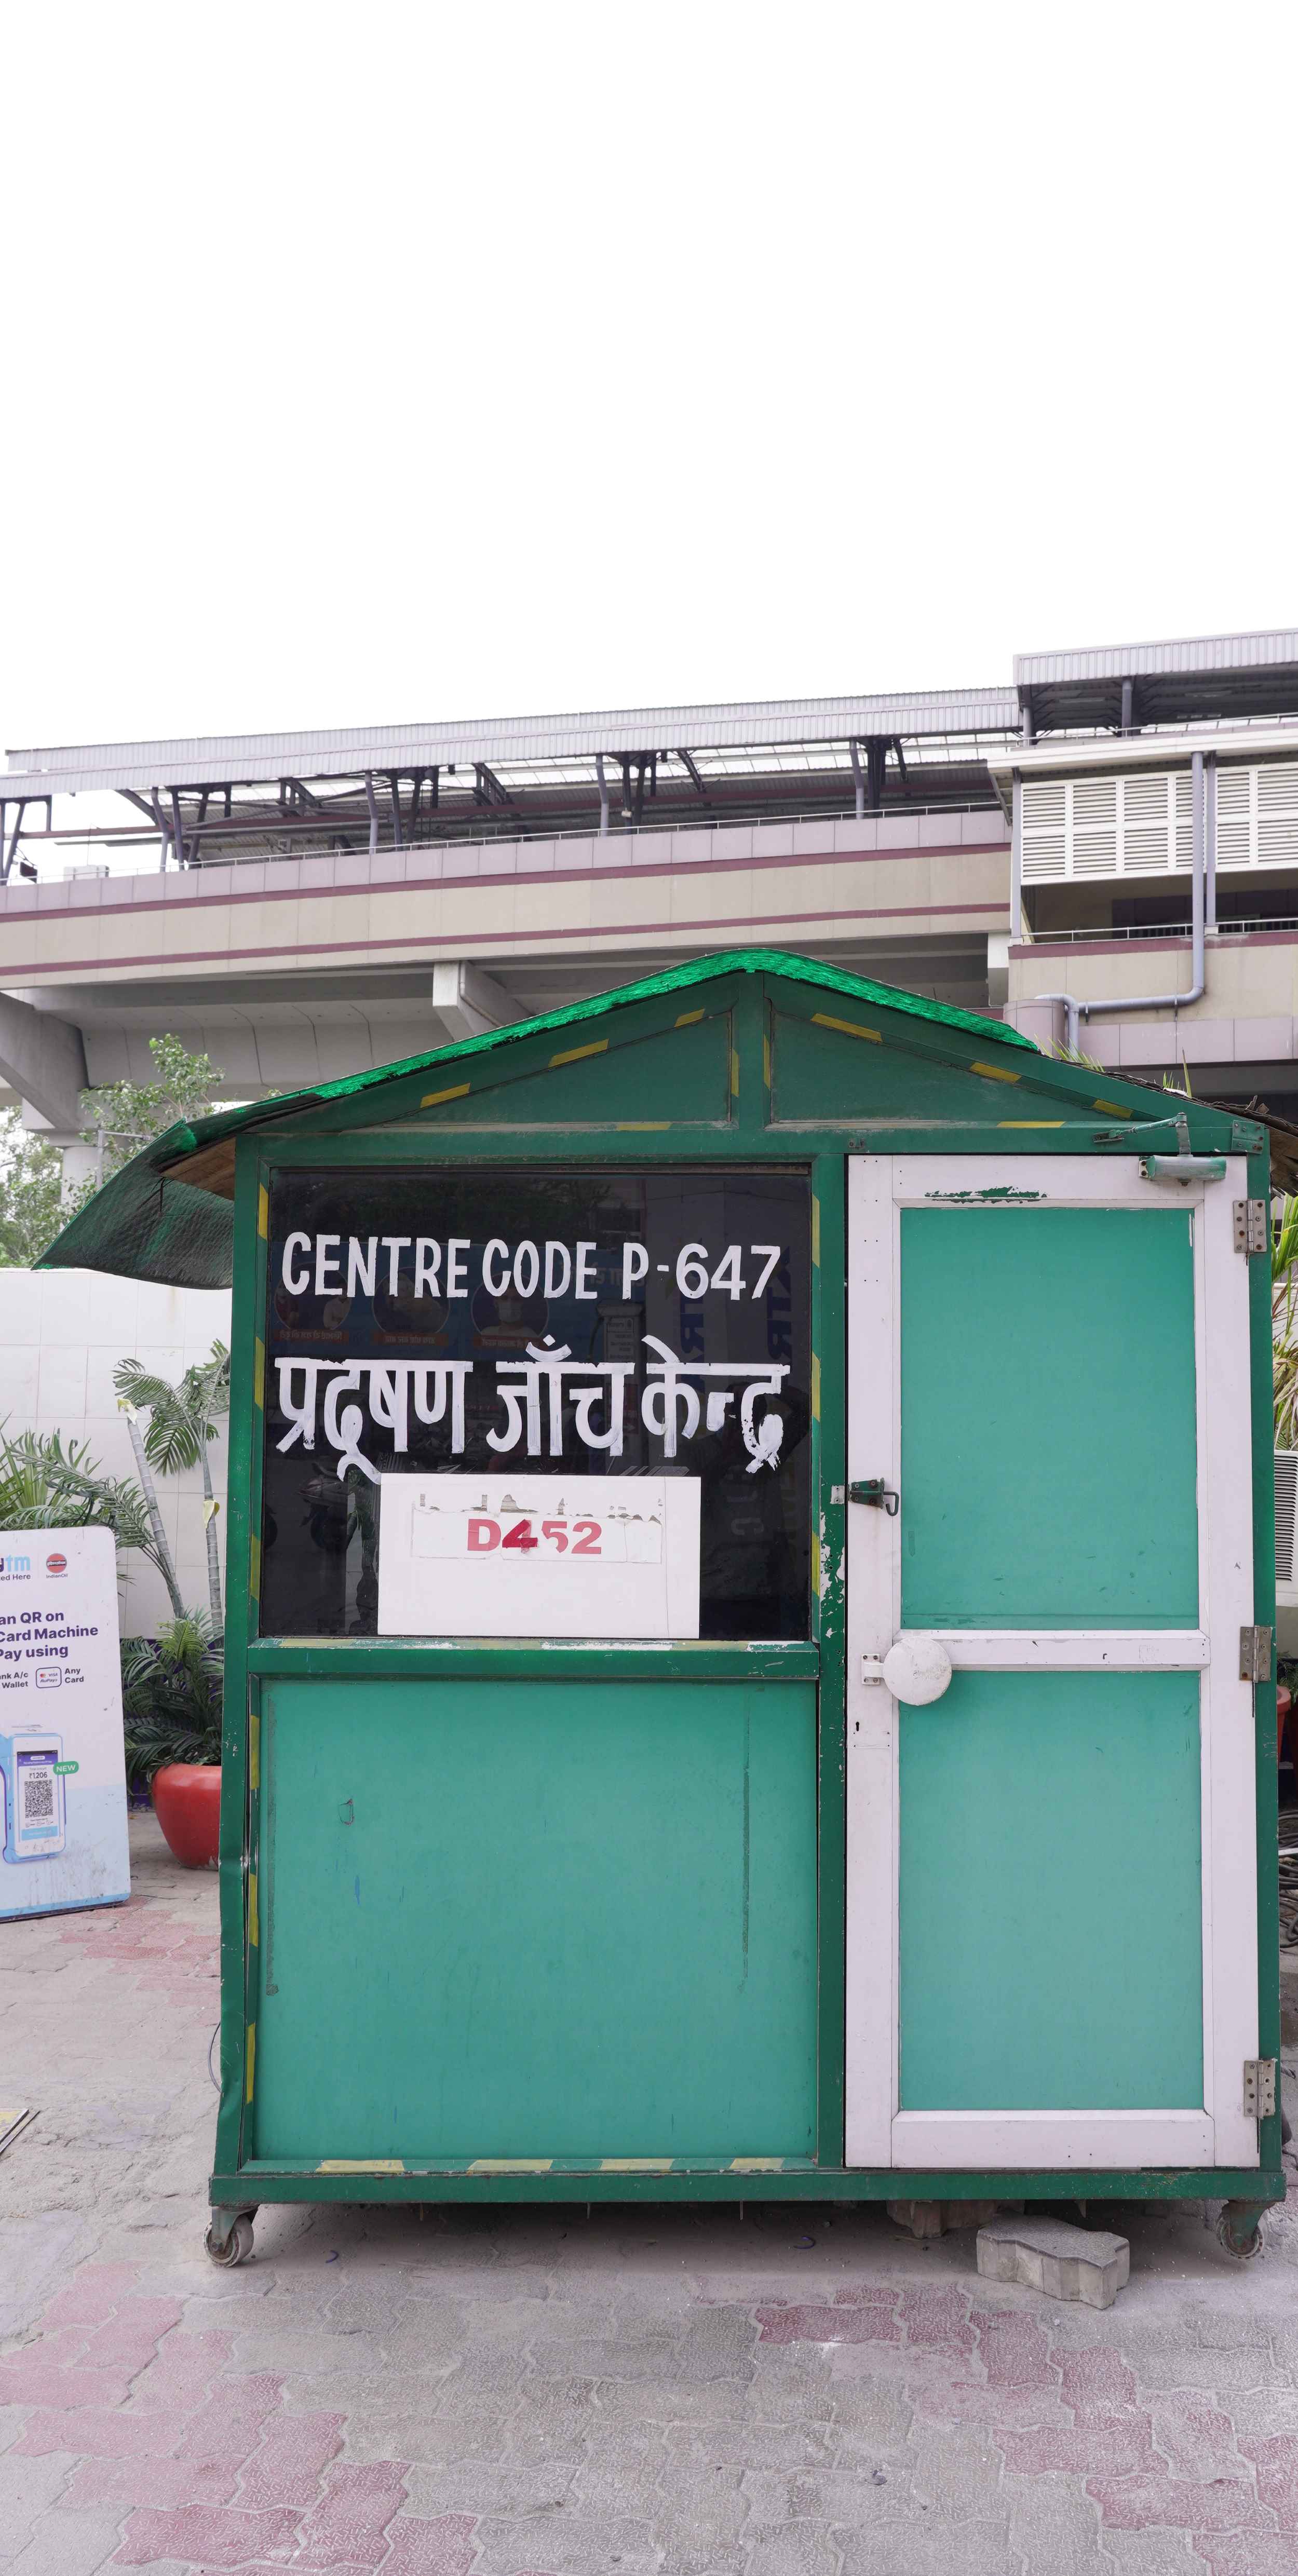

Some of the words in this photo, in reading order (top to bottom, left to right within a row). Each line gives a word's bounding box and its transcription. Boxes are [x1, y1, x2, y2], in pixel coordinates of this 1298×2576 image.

[282, 1231, 471, 1298] CENTRE
[482, 1238, 598, 1299] CODE
[622, 1241, 781, 1300] P-647
[274, 1357, 474, 1484] प्रदूषण
[467, 1519, 602, 1554] D452
[20, 1611, 42, 1624] QR
[45, 1612, 64, 1622] on
[34, 1625, 99, 1640] Machine
[25, 1644, 69, 1658] using
[2, 1680, 29, 1689] Wallet
